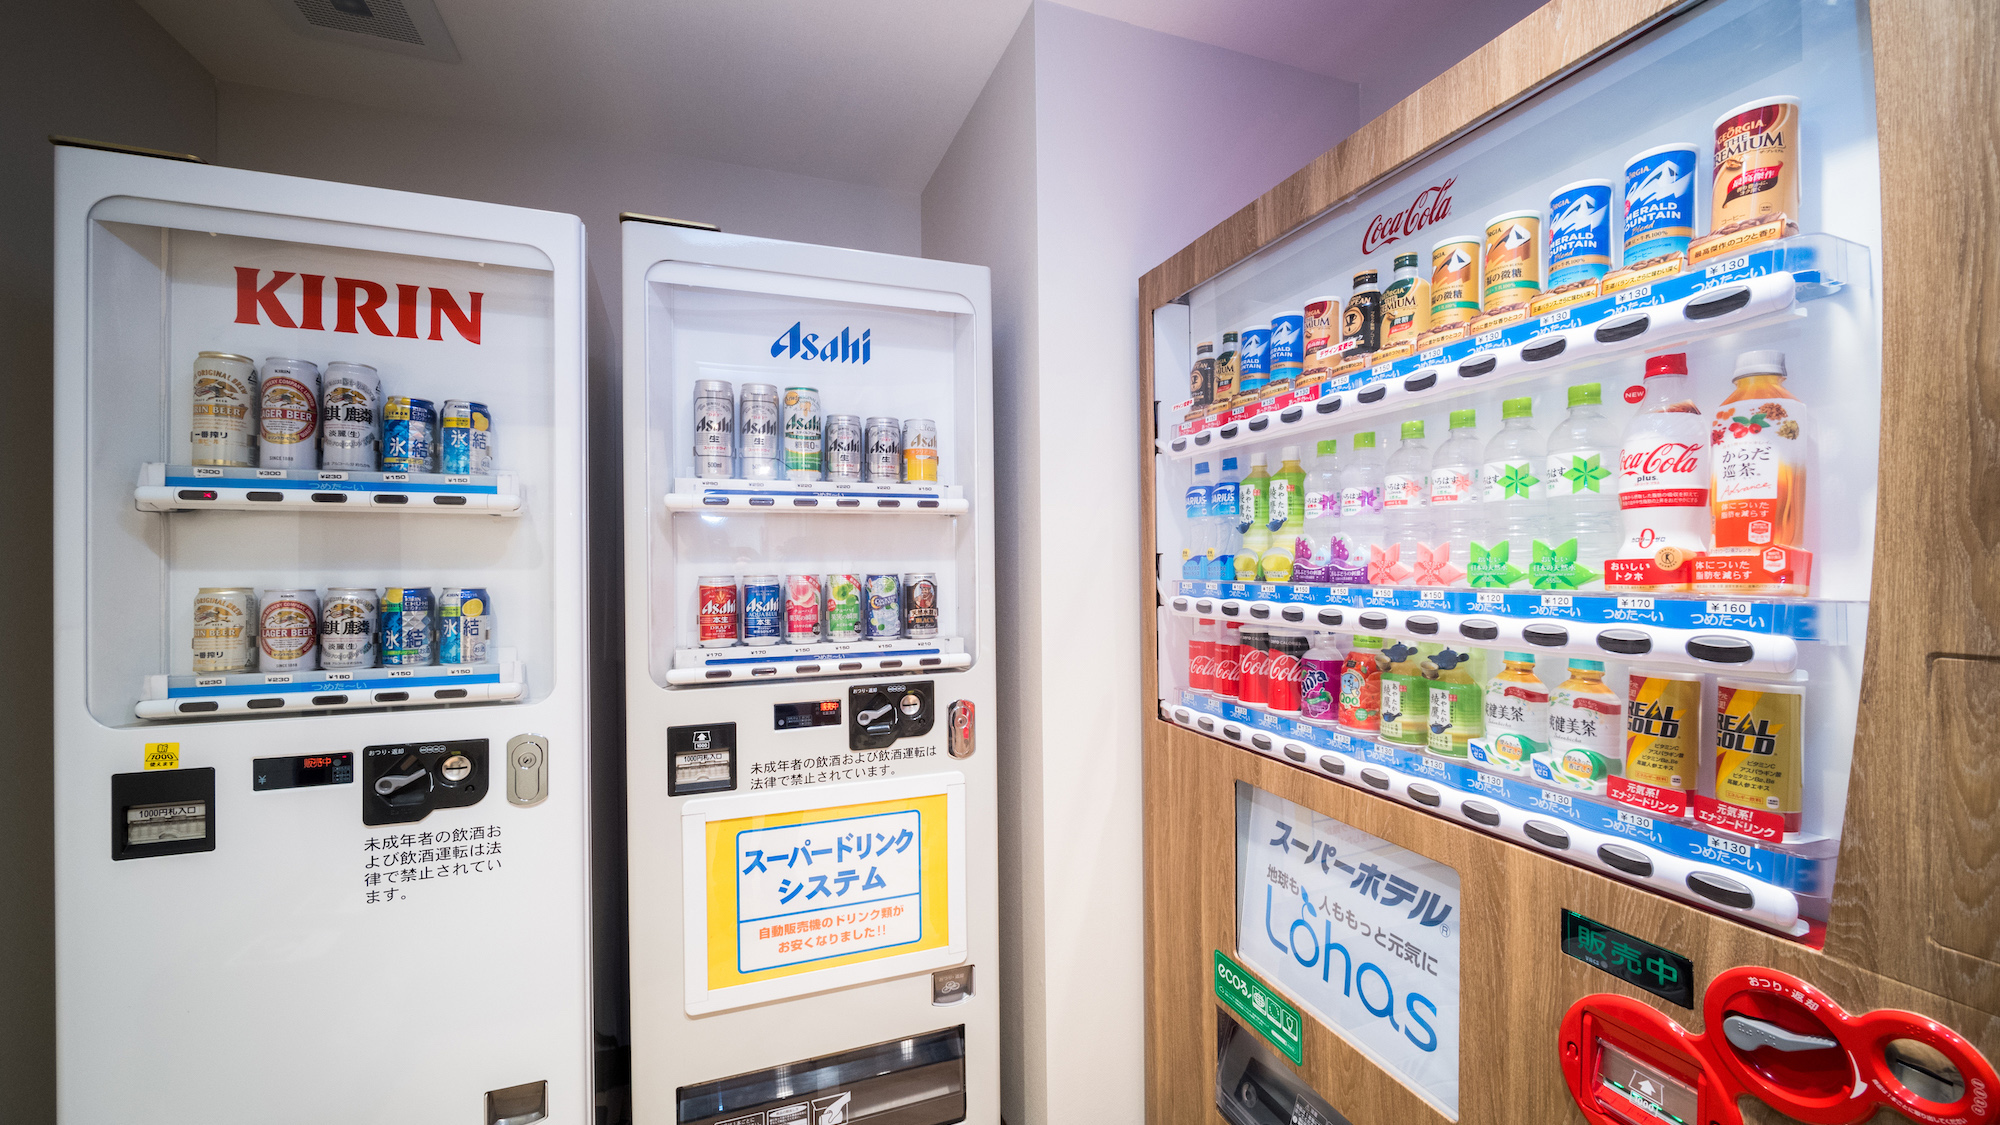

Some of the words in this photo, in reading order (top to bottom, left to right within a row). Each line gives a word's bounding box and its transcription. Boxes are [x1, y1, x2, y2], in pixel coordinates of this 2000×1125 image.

[1713, 131, 1786, 168] REMIUM
[1361, 175, 1459, 256] Coca-Cola
[1625, 202, 1678, 221] MERALD
[1624, 211, 1681, 233] OUNTAIN
[1550, 232, 1594, 249] MERALD
[1694, 227, 1777, 259] 最高傑作のコクと香り
[1710, 258, 1745, 275] ¥130
[1618, 288, 1648, 302] ¥130
[233, 266, 484, 345] KIRIN
[1542, 311, 1568, 324] ¥130
[770, 321, 871, 366] Asahi
[1478, 331, 1500, 343] ¥130
[1422, 349, 1441, 359] ¥130
[1624, 390, 1645, 398] NEW
[212, 405, 241, 416] BEER
[286, 409, 312, 422] BEER
[696, 416, 733, 433] Asahi
[741, 419, 777, 436] Asahi
[389, 437, 429, 458] 氷結
[450, 429, 487, 451] 氷結
[828, 438, 860, 453] Asahi
[1722, 446, 1772, 463] からだ
[1636, 475, 1658, 483] plus
[1722, 463, 1756, 479] 巡茶
[1720, 509, 1770, 519] 脂肪を減らす
[1721, 501, 1770, 511] 体についた
[1610, 562, 1651, 571] おいしい
[1695, 560, 1751, 570] 体についた
[1615, 572, 1644, 582] トクホ
[1695, 570, 1753, 581] 脂肪を減らす
[1423, 591, 1442, 599] ¥150
[1544, 597, 1570, 605] ¥120
[701, 599, 736, 615] Asahi
[746, 597, 779, 613] Asahi
[1621, 599, 1651, 608] ¥170
[1711, 603, 1747, 613] ¥160
[209, 628, 236, 637] BEER
[261, 629, 288, 638] LAGER
[290, 627, 313, 636] BEER
[444, 619, 481, 637] 氷結
[385, 630, 423, 650] 氷結
[1627, 699, 1680, 723] REAL
[1717, 711, 1777, 738] REAL
[1334, 734, 1350, 743] ¥130
[1654, 742, 1679, 751] ビタミンC
[683, 754, 723, 764] 1000円札入口
[1376, 746, 1393, 756] ¥130
[1473, 751, 1484, 760] ゼロ
[751, 744, 937, 775] 未成年者の飲酒および飲酒運転は
[1425, 758, 1443, 769] ¥130
[1746, 760, 1776, 769] ビタミンC
[750, 764, 897, 791] 法律で禁止されています。
[1479, 774, 1502, 786] ¥130
[1536, 768, 1549, 777] ゼロ
[1740, 766, 1782, 778] アスパラギン酸
[1627, 782, 1660, 799] 元気系!
[1727, 779, 1770, 792] 高麗人参エキス
[1544, 792, 1570, 805] ¥130
[1611, 788, 1680, 813] エナジードリンク
[139, 806, 196, 818] 1000円札入口
[1620, 812, 1650, 828] ¥130
[1716, 803, 1754, 822] 元気系!
[1699, 810, 1776, 839] エナジードリンク
[364, 824, 502, 852] 未成年者の飲酒お
[742, 828, 914, 876] スーパードリンク
[1711, 838, 1747, 855] ¥130
[364, 841, 502, 869] よび飲酒運転は法
[364, 859, 502, 887] 律で禁止されてい
[1269, 819, 1453, 928] スーパーホテル
[778, 866, 887, 905] システム
[366, 887, 407, 905] ます。
[759, 904, 905, 941] 自動販売機のドリンク類が
[1266, 863, 1300, 897] 地球も
[1319, 895, 1438, 977] 人ももっと元気に
[1577, 923, 1679, 986] 販売中
[1747, 975, 1820, 1012] おつり・返却
